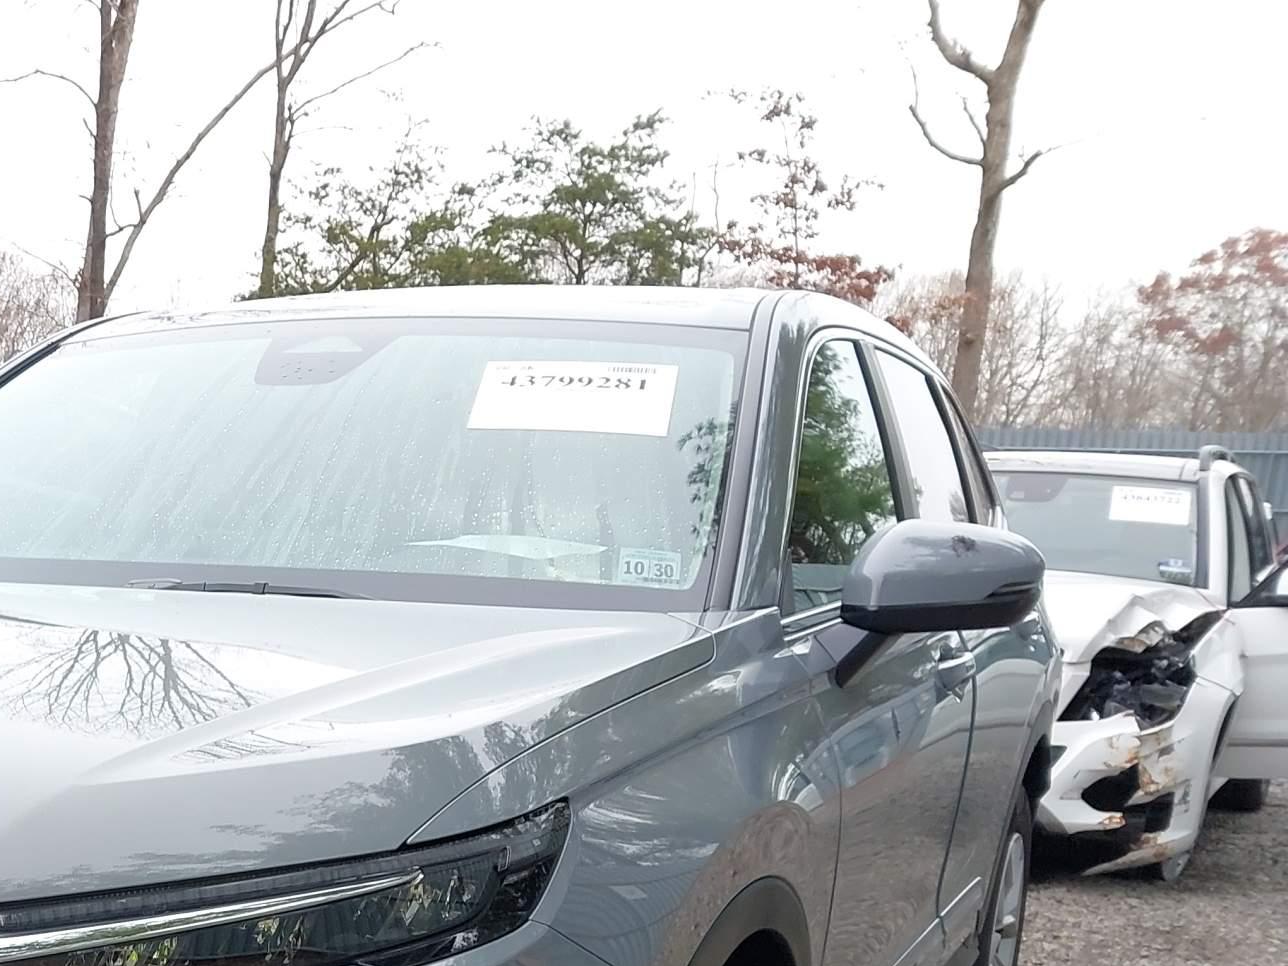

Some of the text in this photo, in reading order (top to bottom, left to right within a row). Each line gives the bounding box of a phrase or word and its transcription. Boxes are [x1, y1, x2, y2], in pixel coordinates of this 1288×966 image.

[500, 374, 648, 392] 43799281
[623, 560, 674, 578] 10 30
